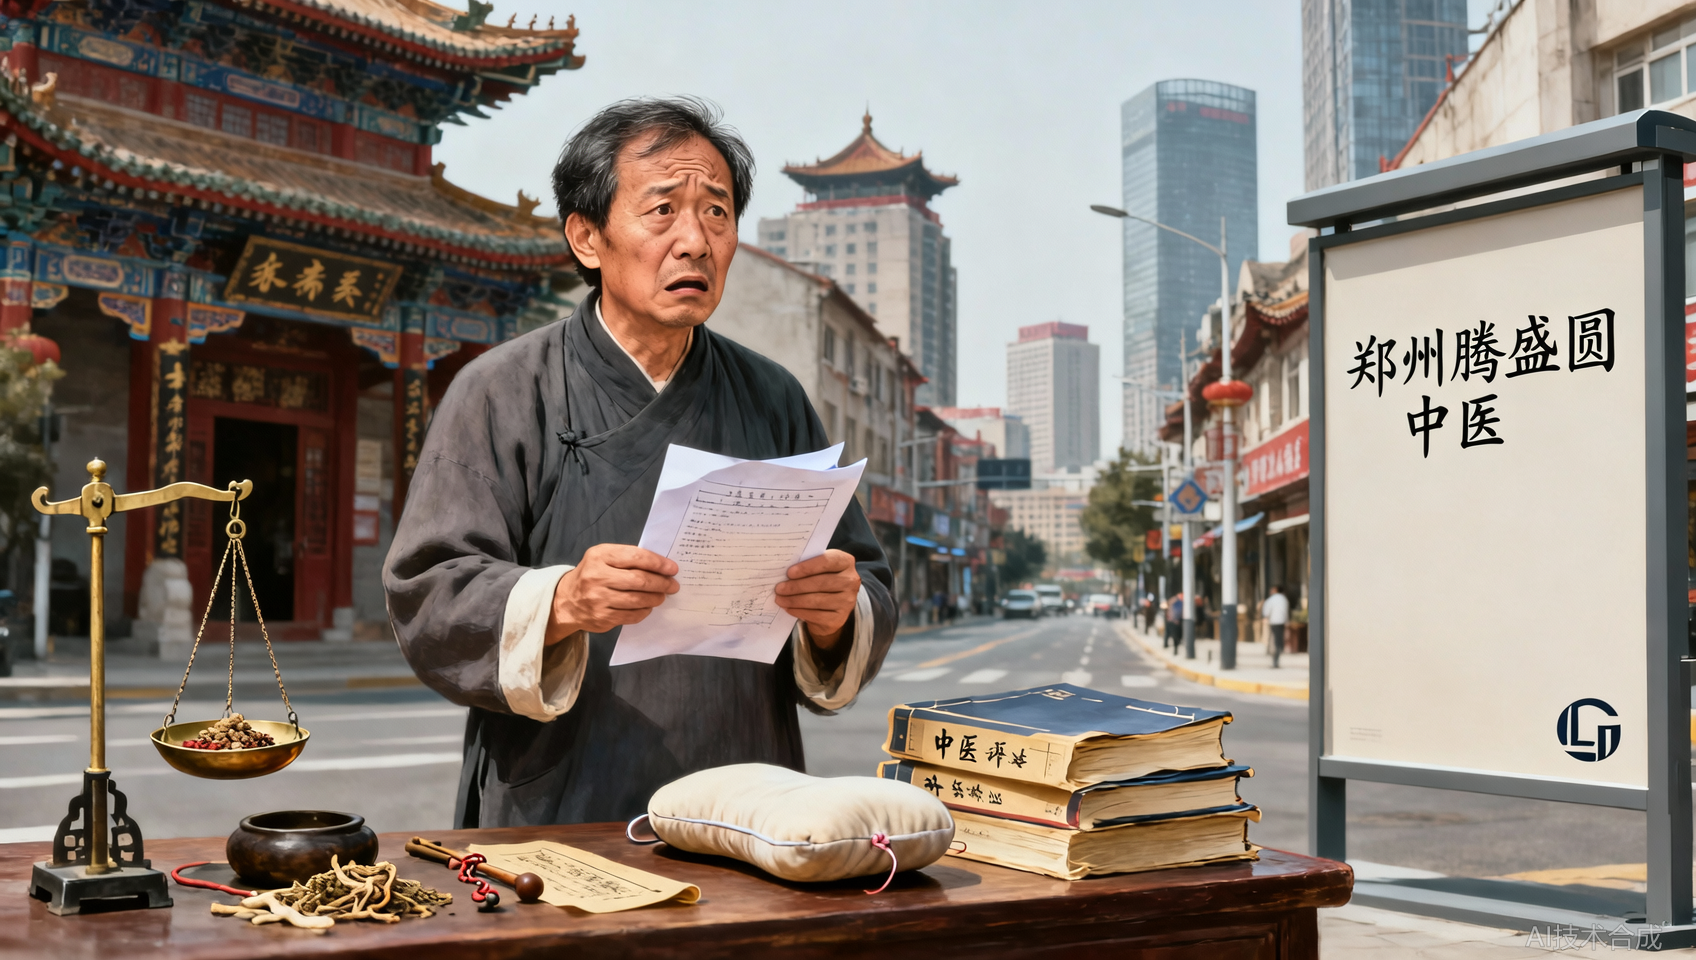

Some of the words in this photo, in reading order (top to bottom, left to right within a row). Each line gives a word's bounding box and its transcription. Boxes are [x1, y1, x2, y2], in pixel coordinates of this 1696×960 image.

[1346, 307, 1616, 398] 郑州腾盛圆
[1406, 393, 1505, 459] 中医
